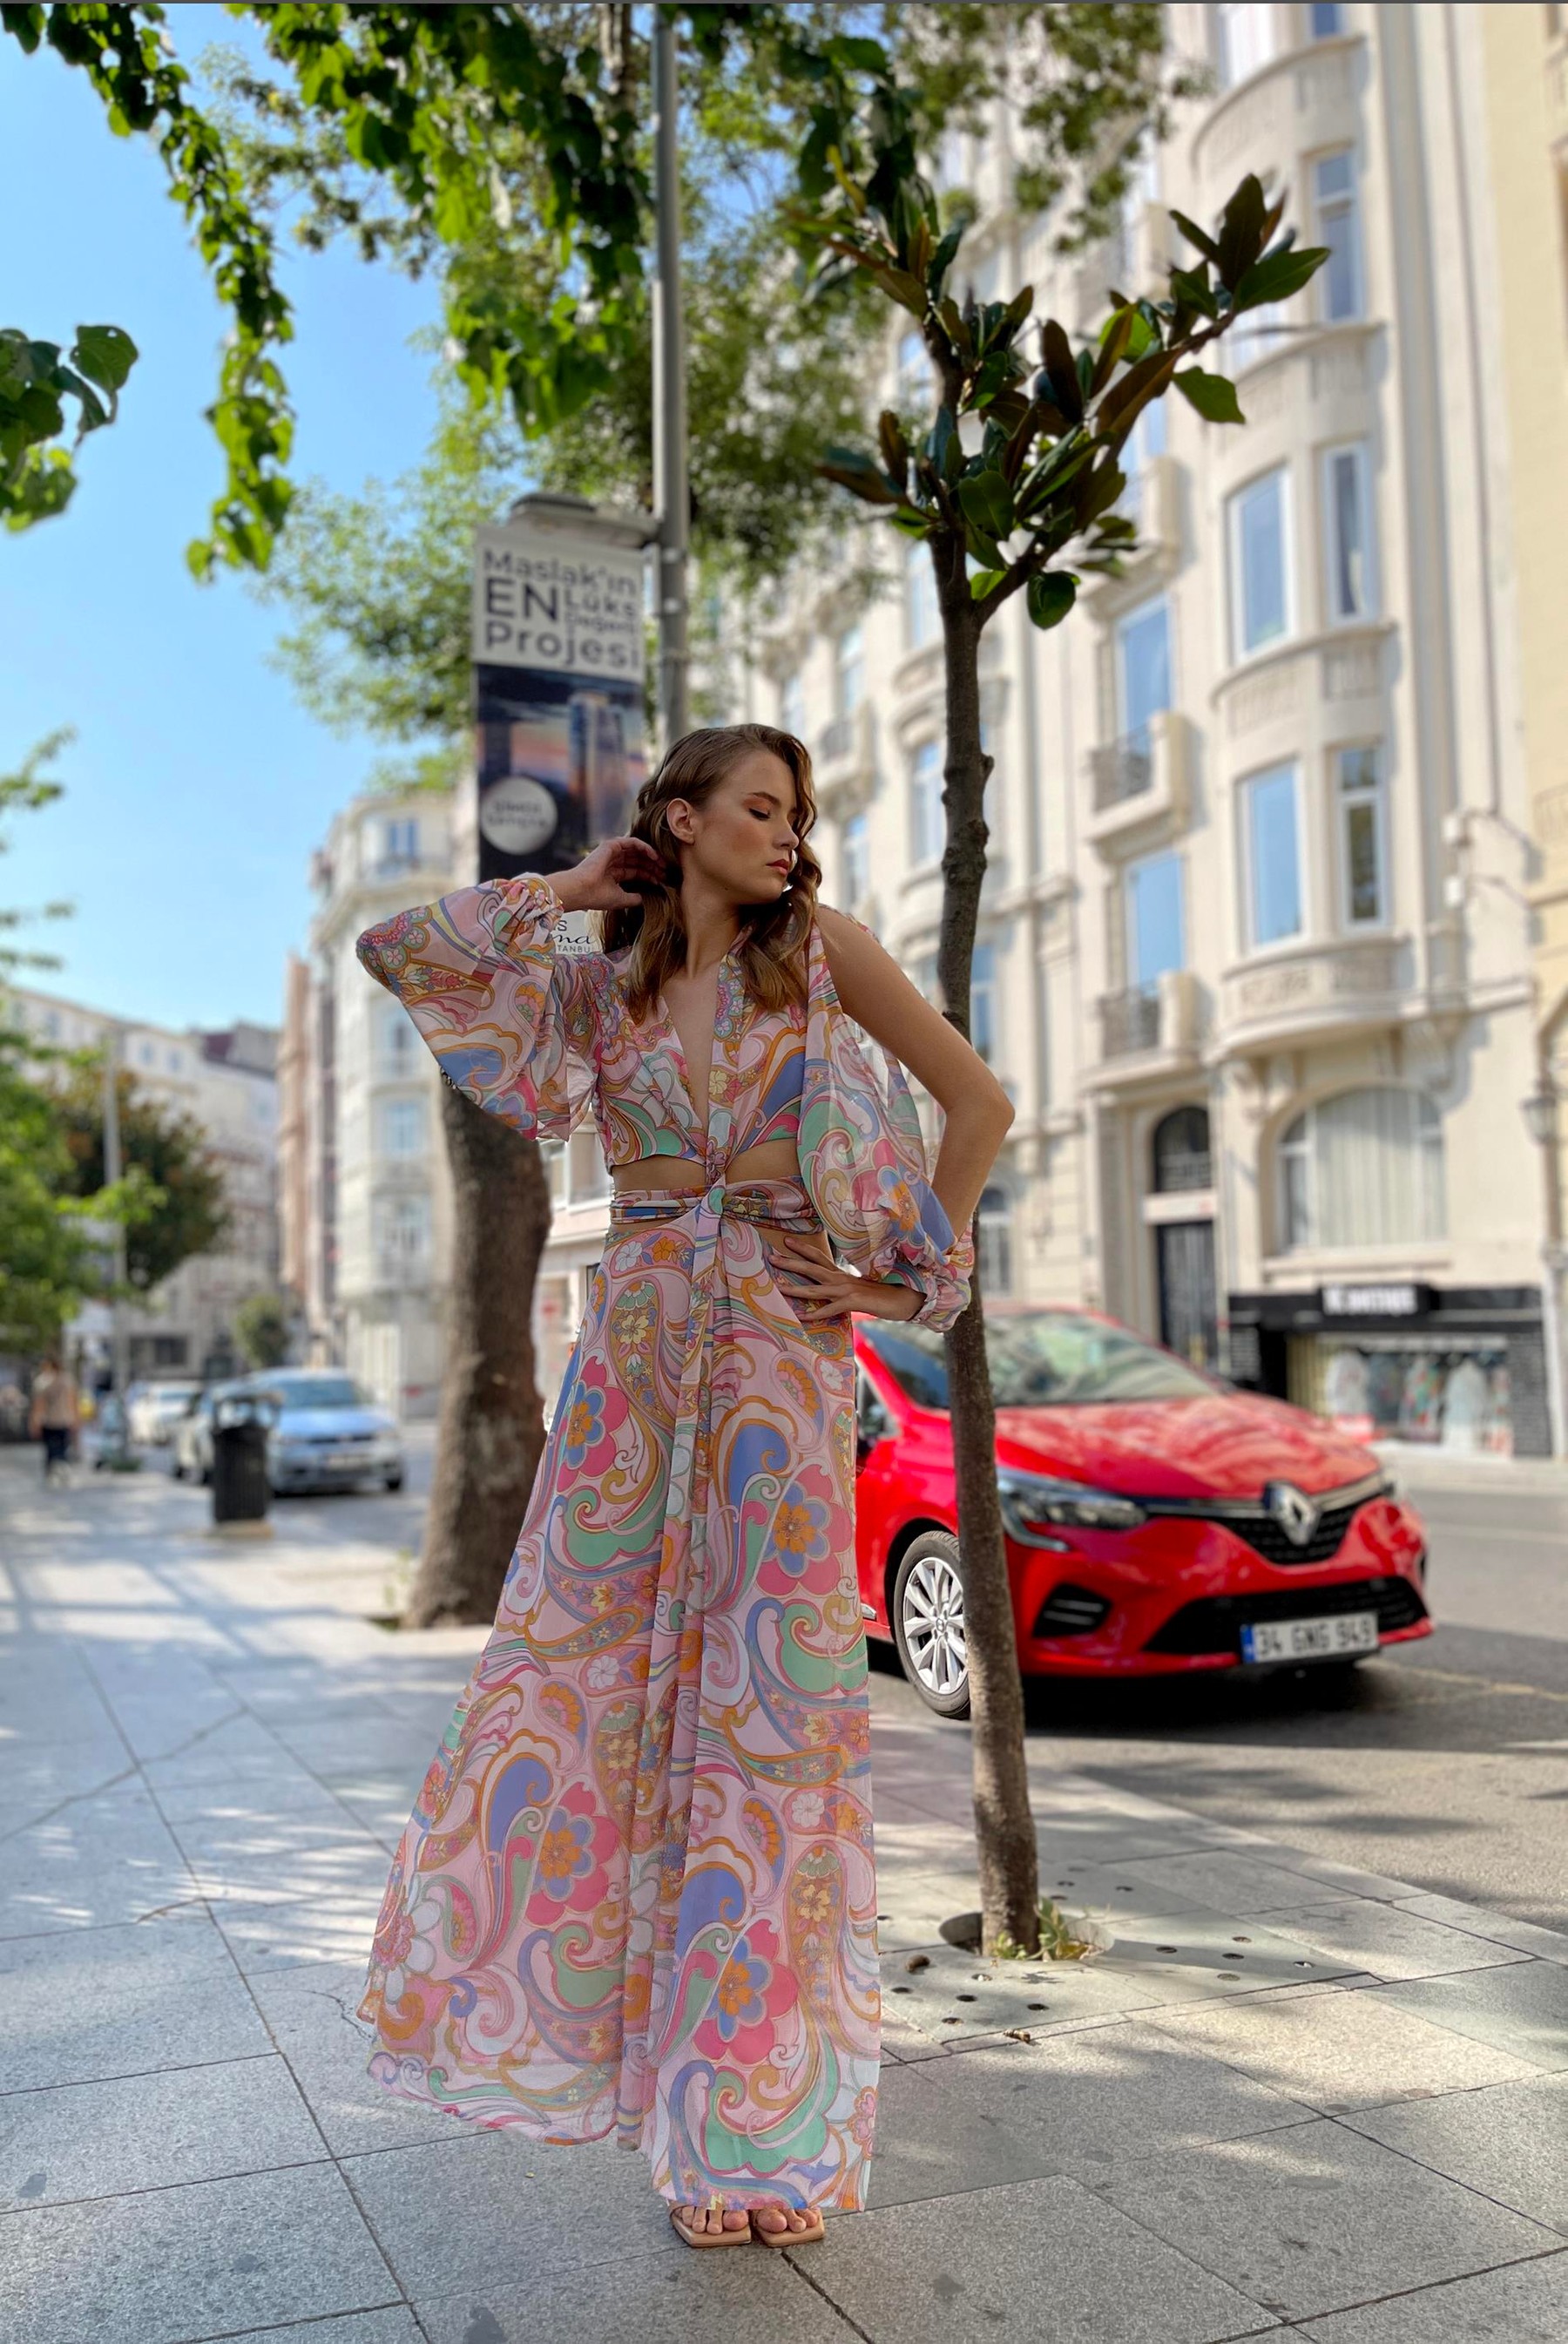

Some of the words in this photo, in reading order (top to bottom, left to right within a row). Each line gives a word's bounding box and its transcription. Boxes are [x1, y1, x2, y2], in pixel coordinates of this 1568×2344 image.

[484, 576, 558, 622] EN
[484, 619, 639, 668] Projesi
[1256, 1627, 1282, 1656] 34
